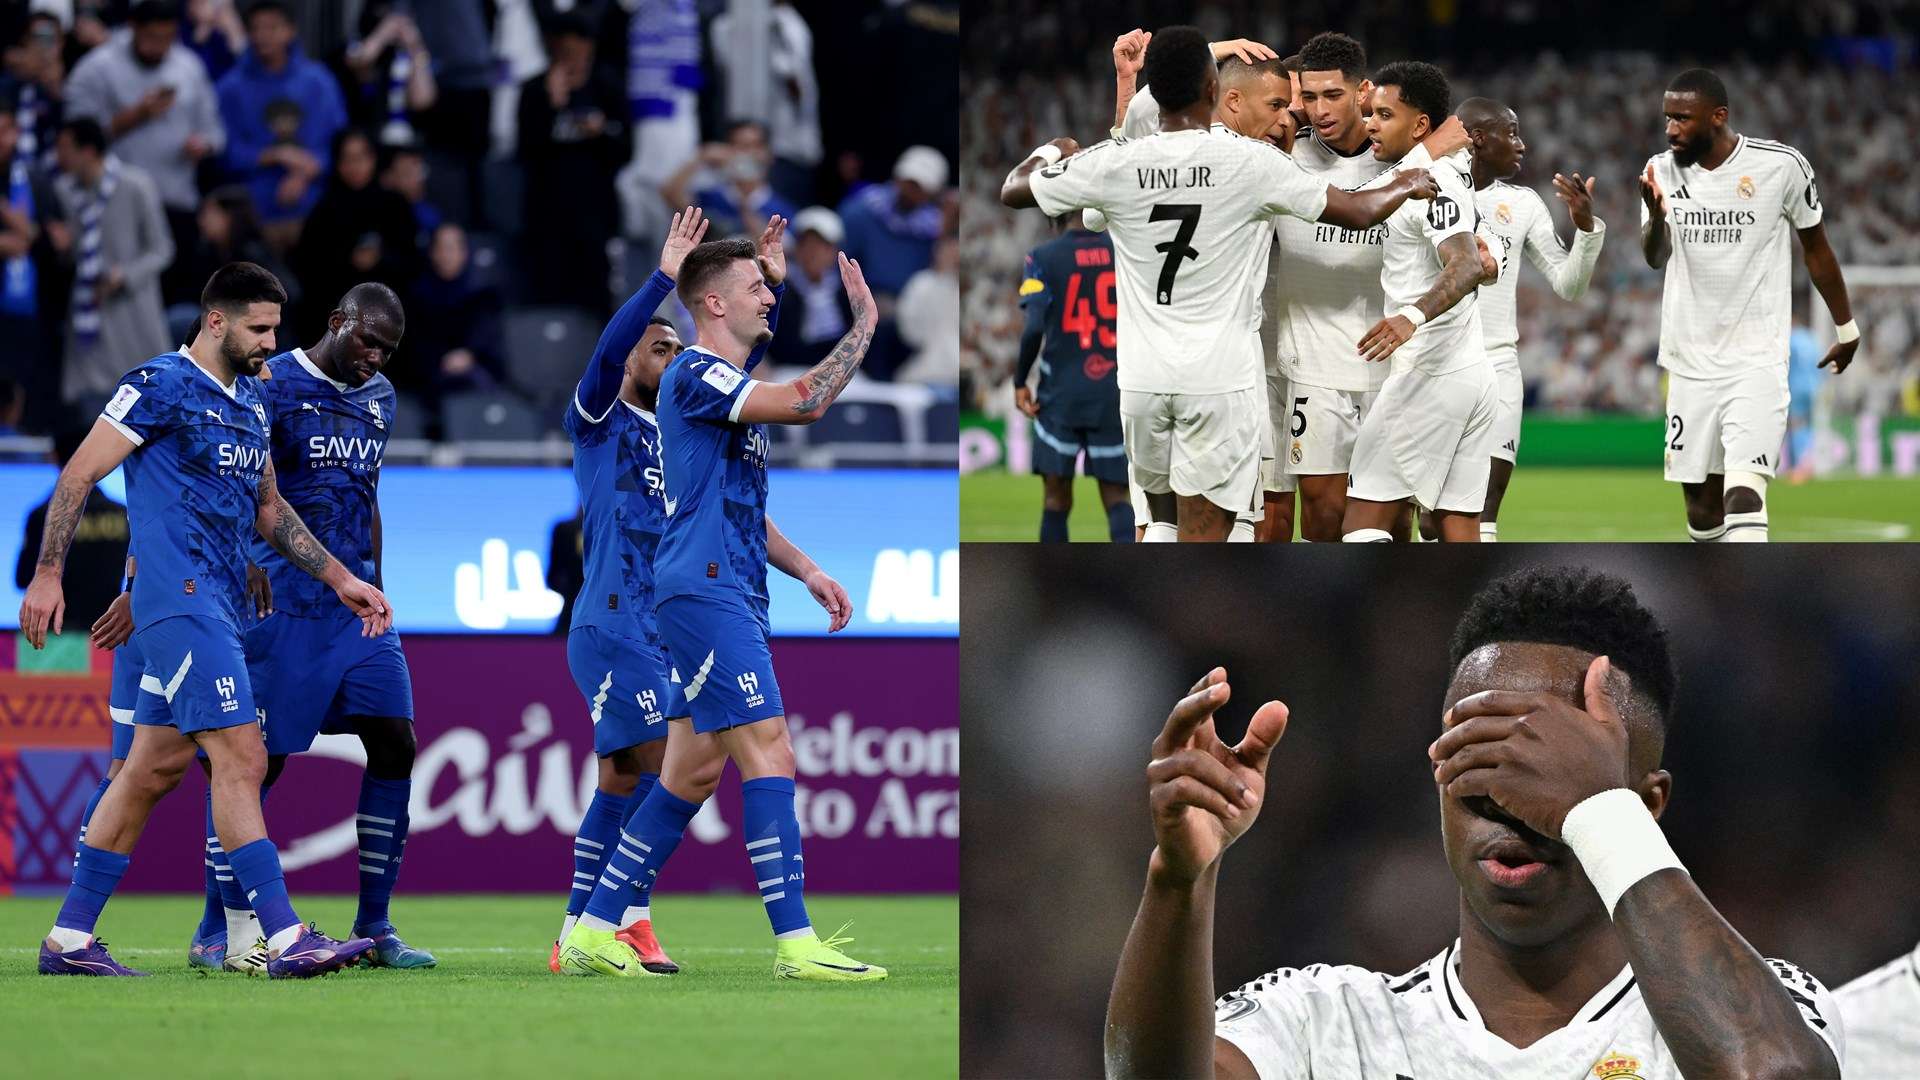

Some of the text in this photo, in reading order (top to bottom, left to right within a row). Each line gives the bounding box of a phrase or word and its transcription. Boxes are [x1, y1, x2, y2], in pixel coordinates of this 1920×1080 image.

[1137, 166, 1216, 189] VINI JR.
[1431, 199, 1457, 229] hp
[1673, 207, 1756, 226] Emirates
[1315, 226, 1336, 243] FLY
[1682, 228, 1742, 243] FLY BETTER
[1147, 204, 1202, 306] 7
[1290, 397, 1309, 437] 5
[1665, 415, 1684, 450] 2
[309, 436, 383, 462] SAVVY
